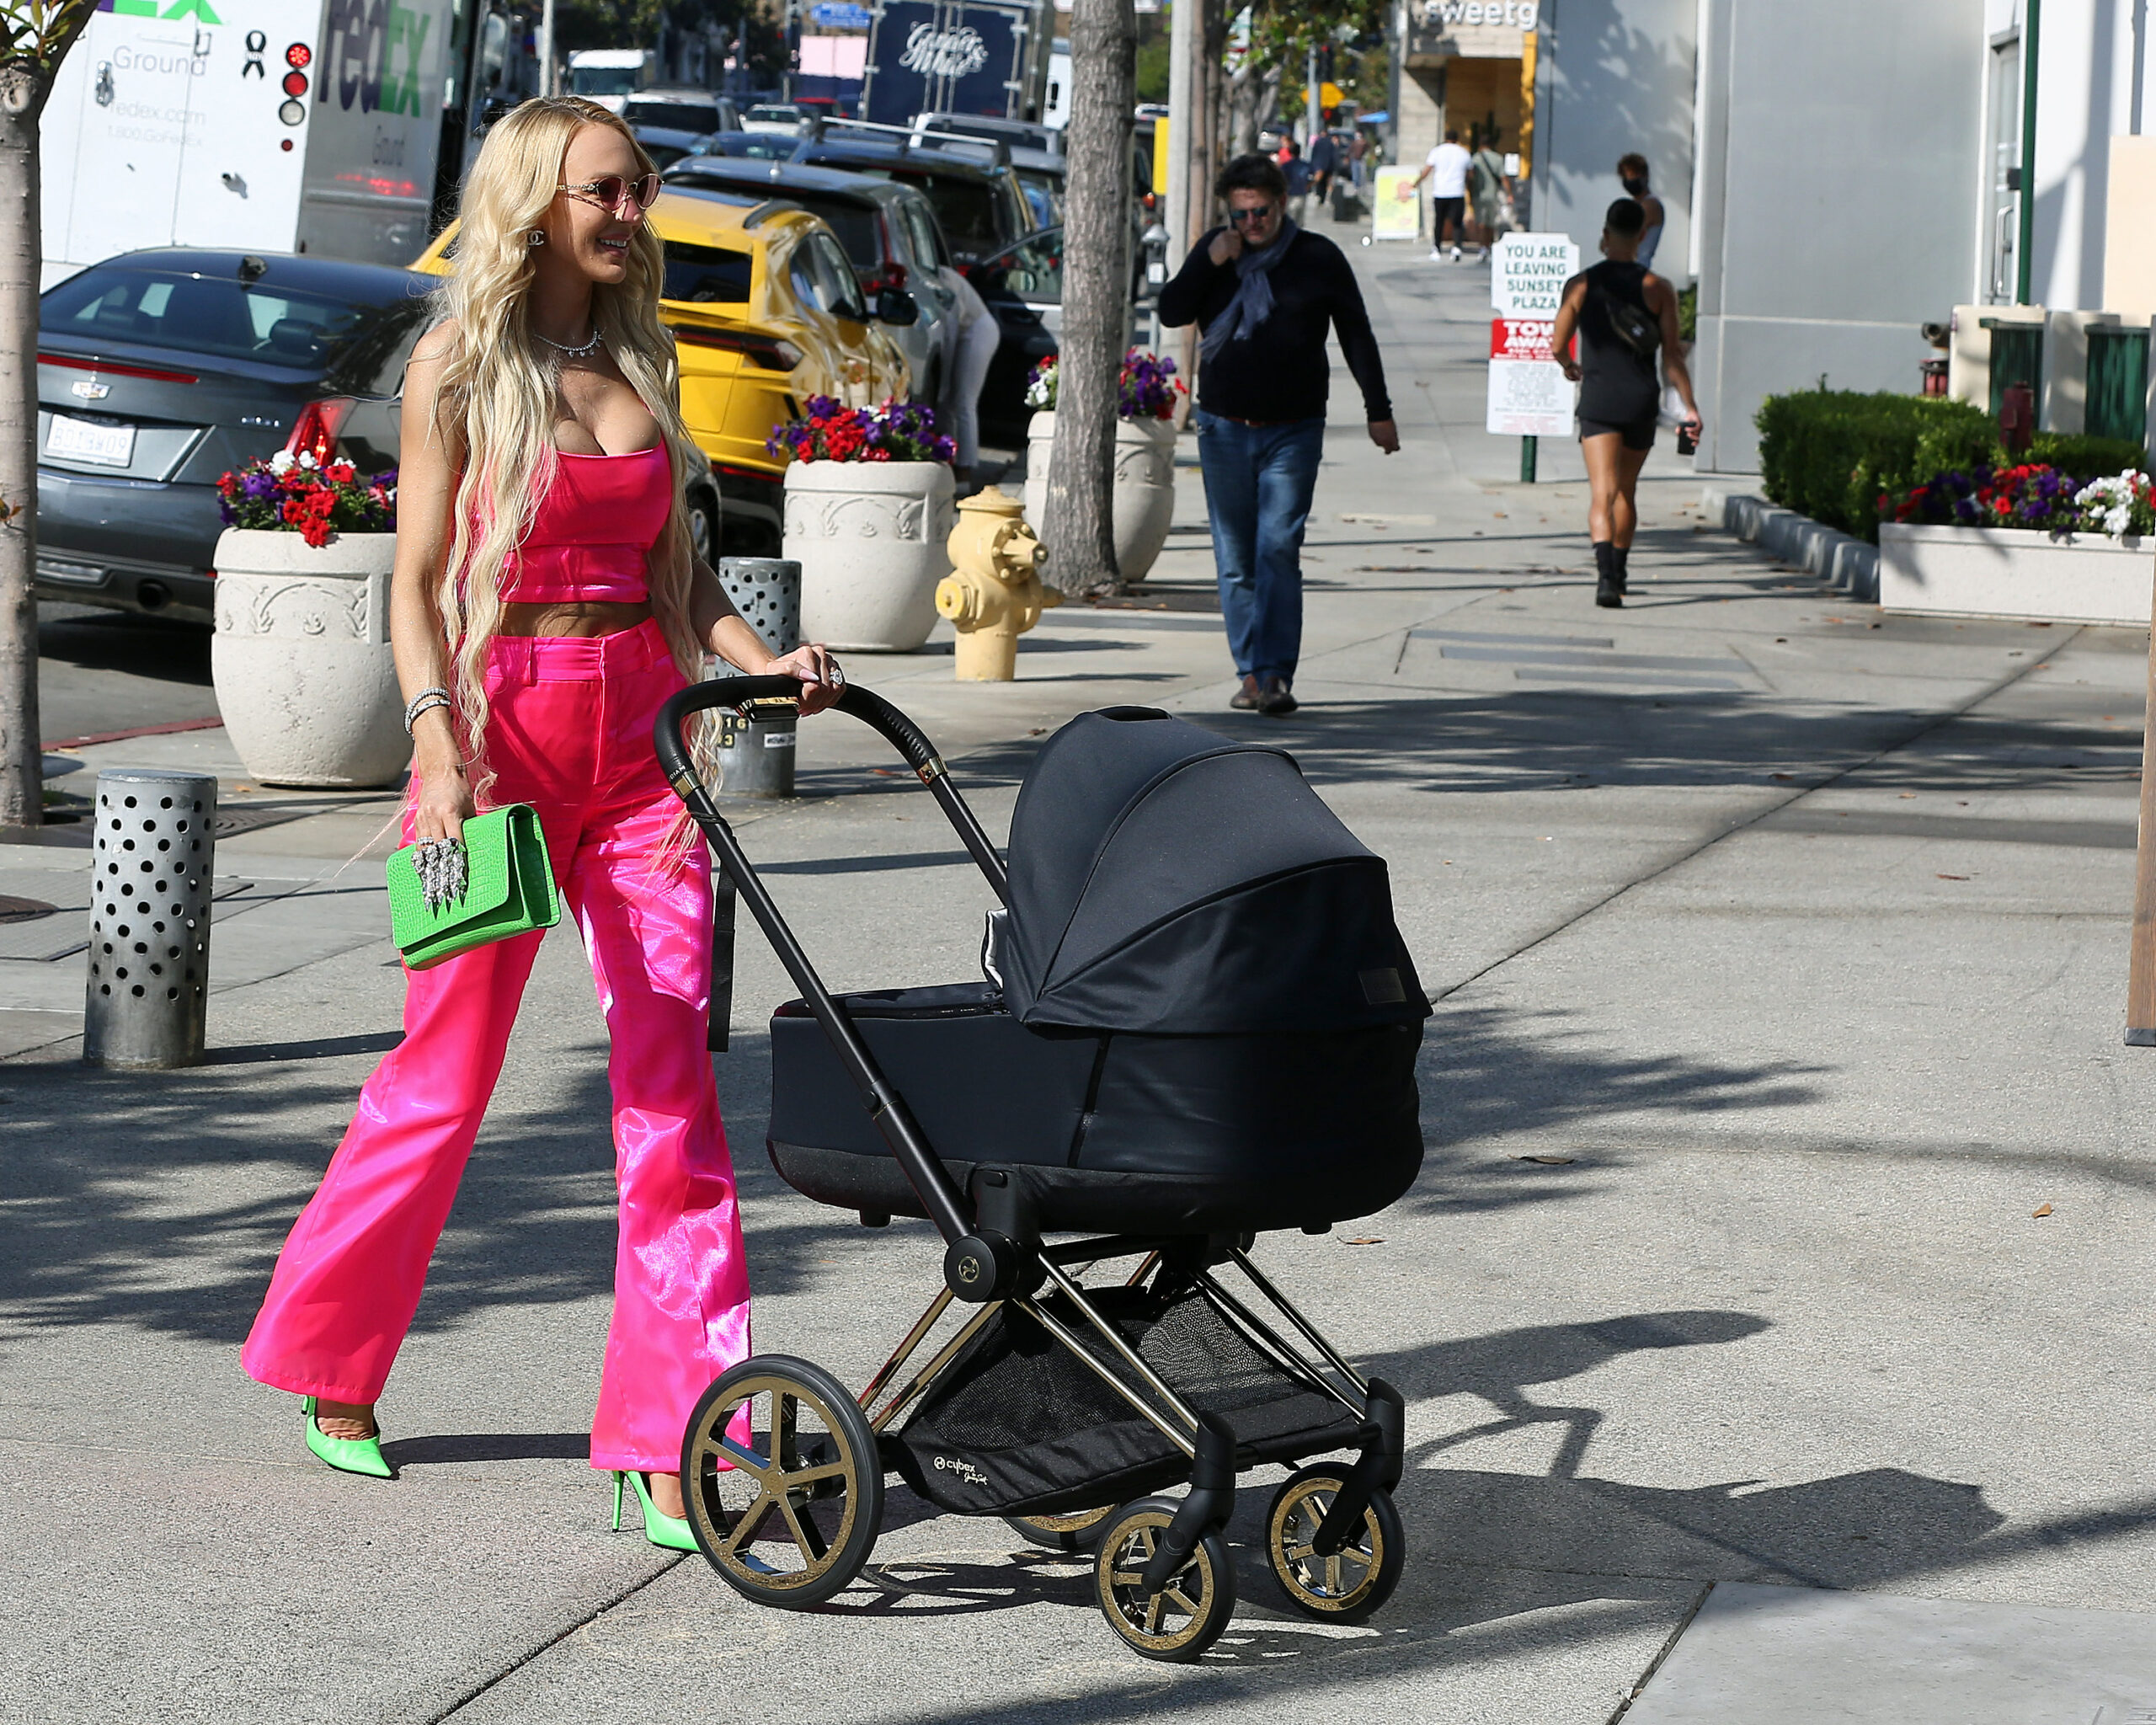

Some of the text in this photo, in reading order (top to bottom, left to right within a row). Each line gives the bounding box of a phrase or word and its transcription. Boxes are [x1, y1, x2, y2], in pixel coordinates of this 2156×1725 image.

[113, 45, 207, 77] Ground
[1505, 245, 1567, 259] YOU ARE
[1505, 262, 1566, 275] LEAVING
[1507, 278, 1563, 292] SUNSET
[1512, 296, 1557, 309] PLAZA
[1503, 337, 1554, 349] AWA
[946, 1458, 976, 1475] cybex
